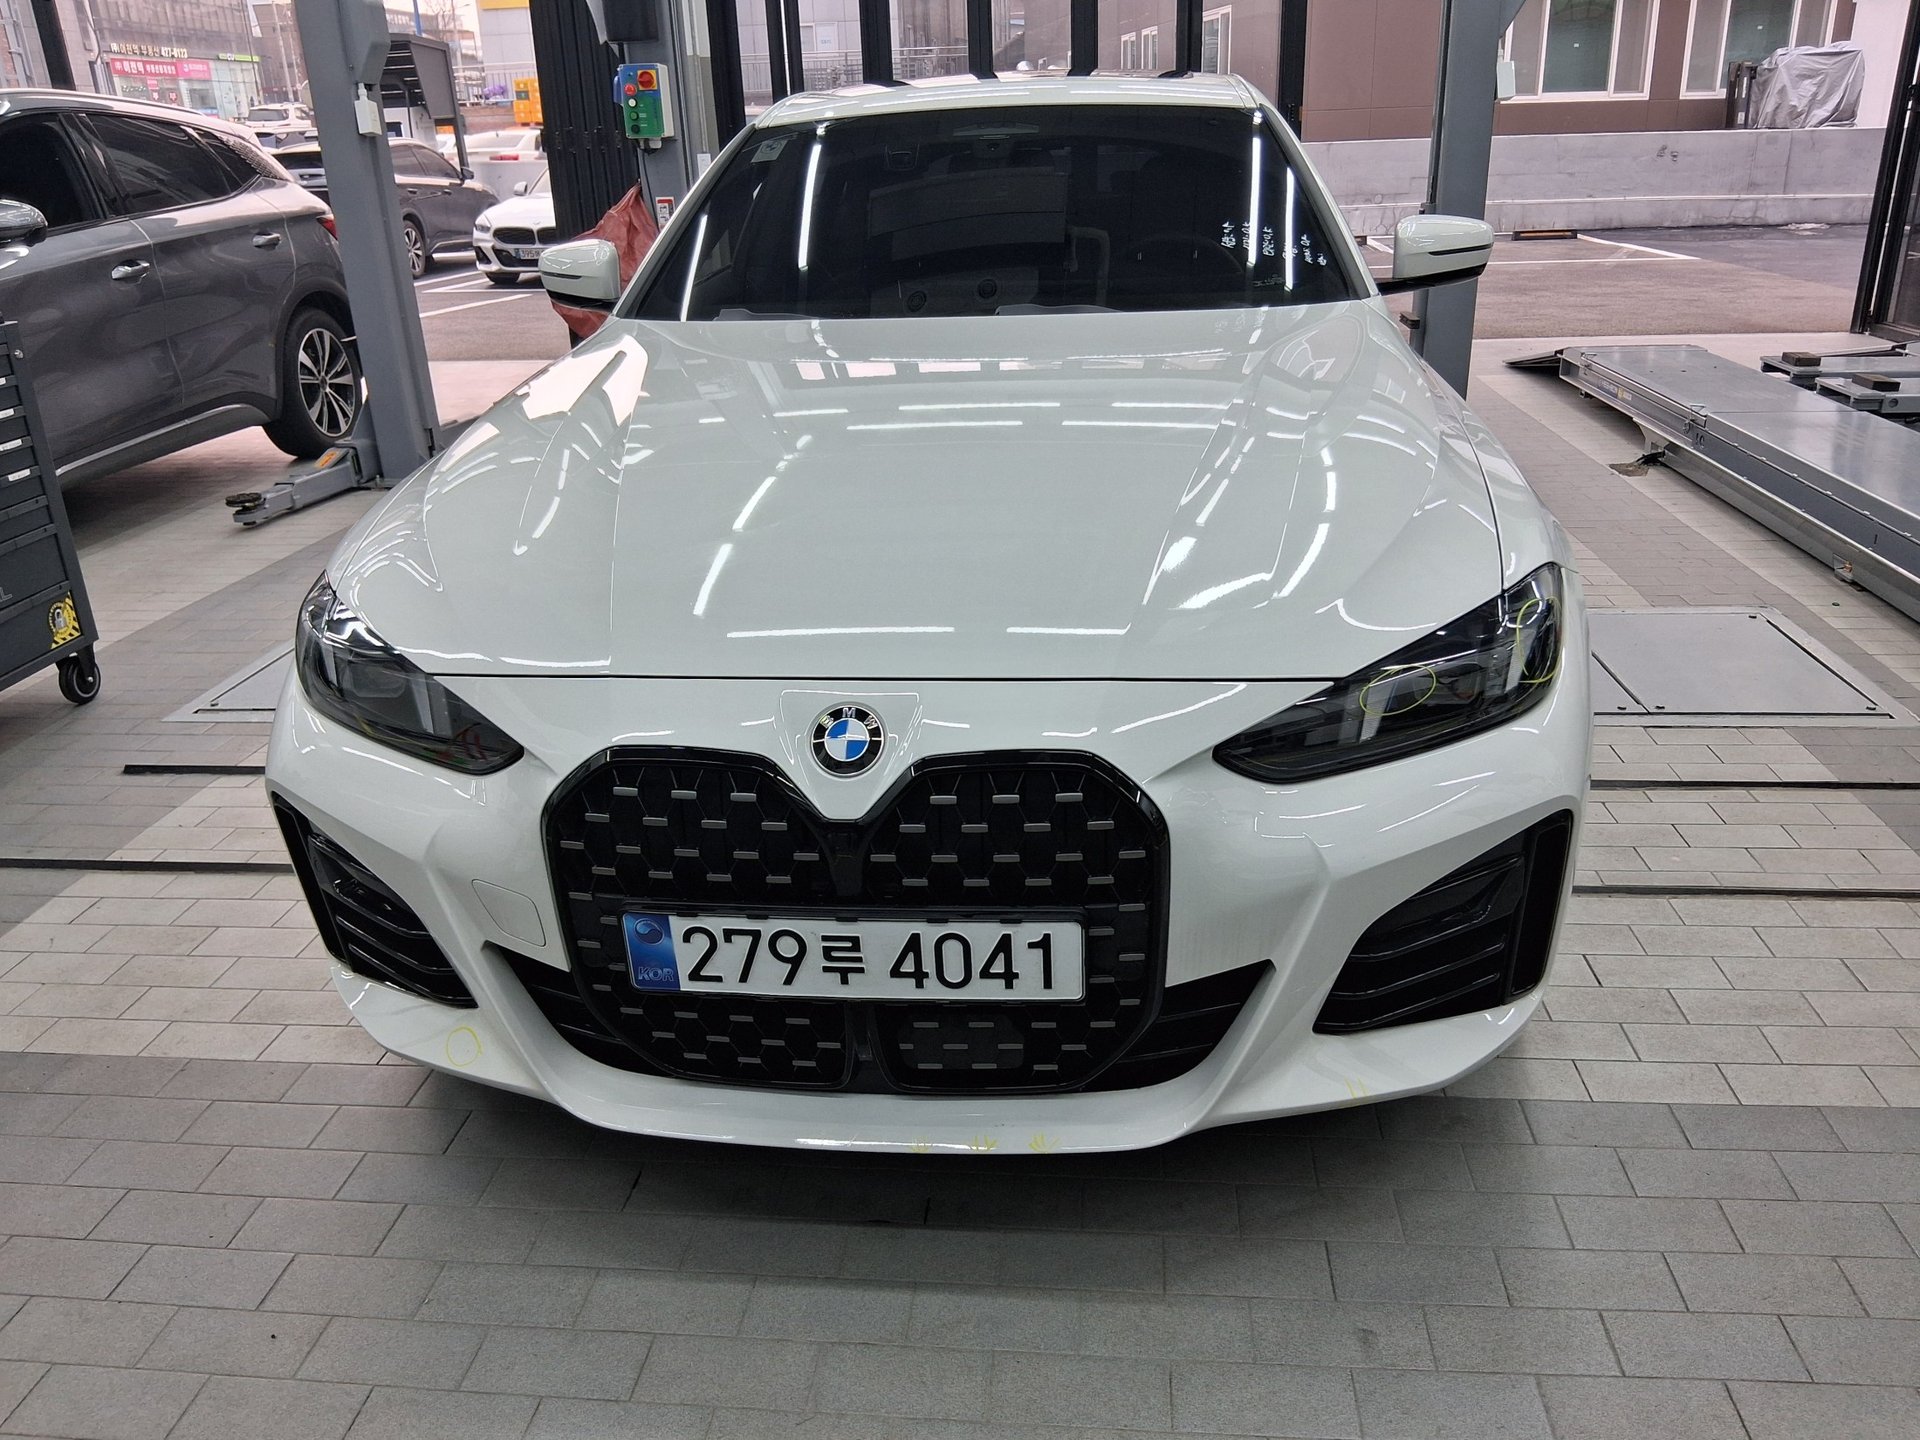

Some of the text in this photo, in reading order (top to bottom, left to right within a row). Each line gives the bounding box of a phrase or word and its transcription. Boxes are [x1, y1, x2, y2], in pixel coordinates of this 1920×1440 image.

[819, 707, 879, 730] BMW
[682, 925, 1055, 990] 279루 4041
[638, 966, 675, 982] KOR
